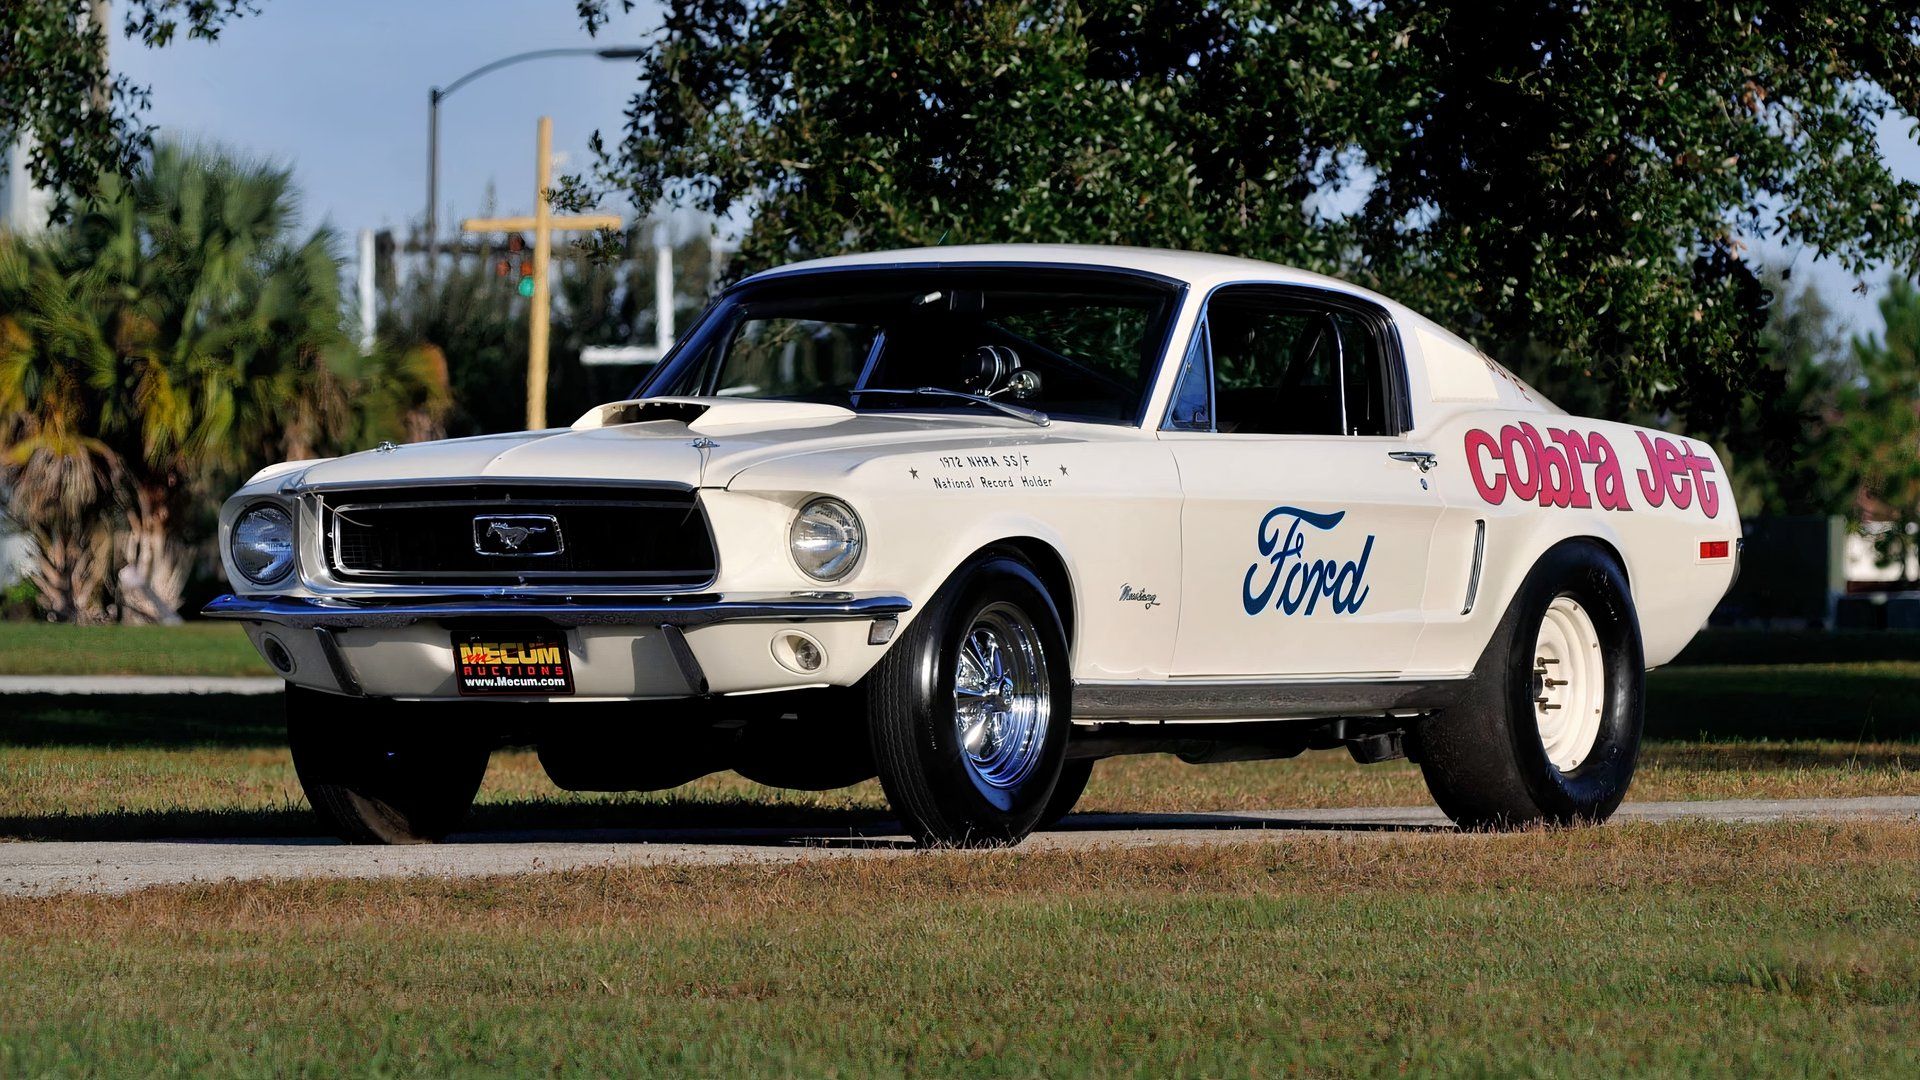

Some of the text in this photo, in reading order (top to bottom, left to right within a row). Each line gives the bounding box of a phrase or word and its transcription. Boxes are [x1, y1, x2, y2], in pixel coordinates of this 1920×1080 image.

[939, 451, 1030, 471] 1972 NHRA SS/F
[933, 476, 1053, 489] National Record Holder
[1243, 505, 1375, 616] Ford
[460, 643, 562, 665] MECUM
[463, 666, 564, 676] AUCTIONS
[464, 676, 566, 687] www.Mecum.com
